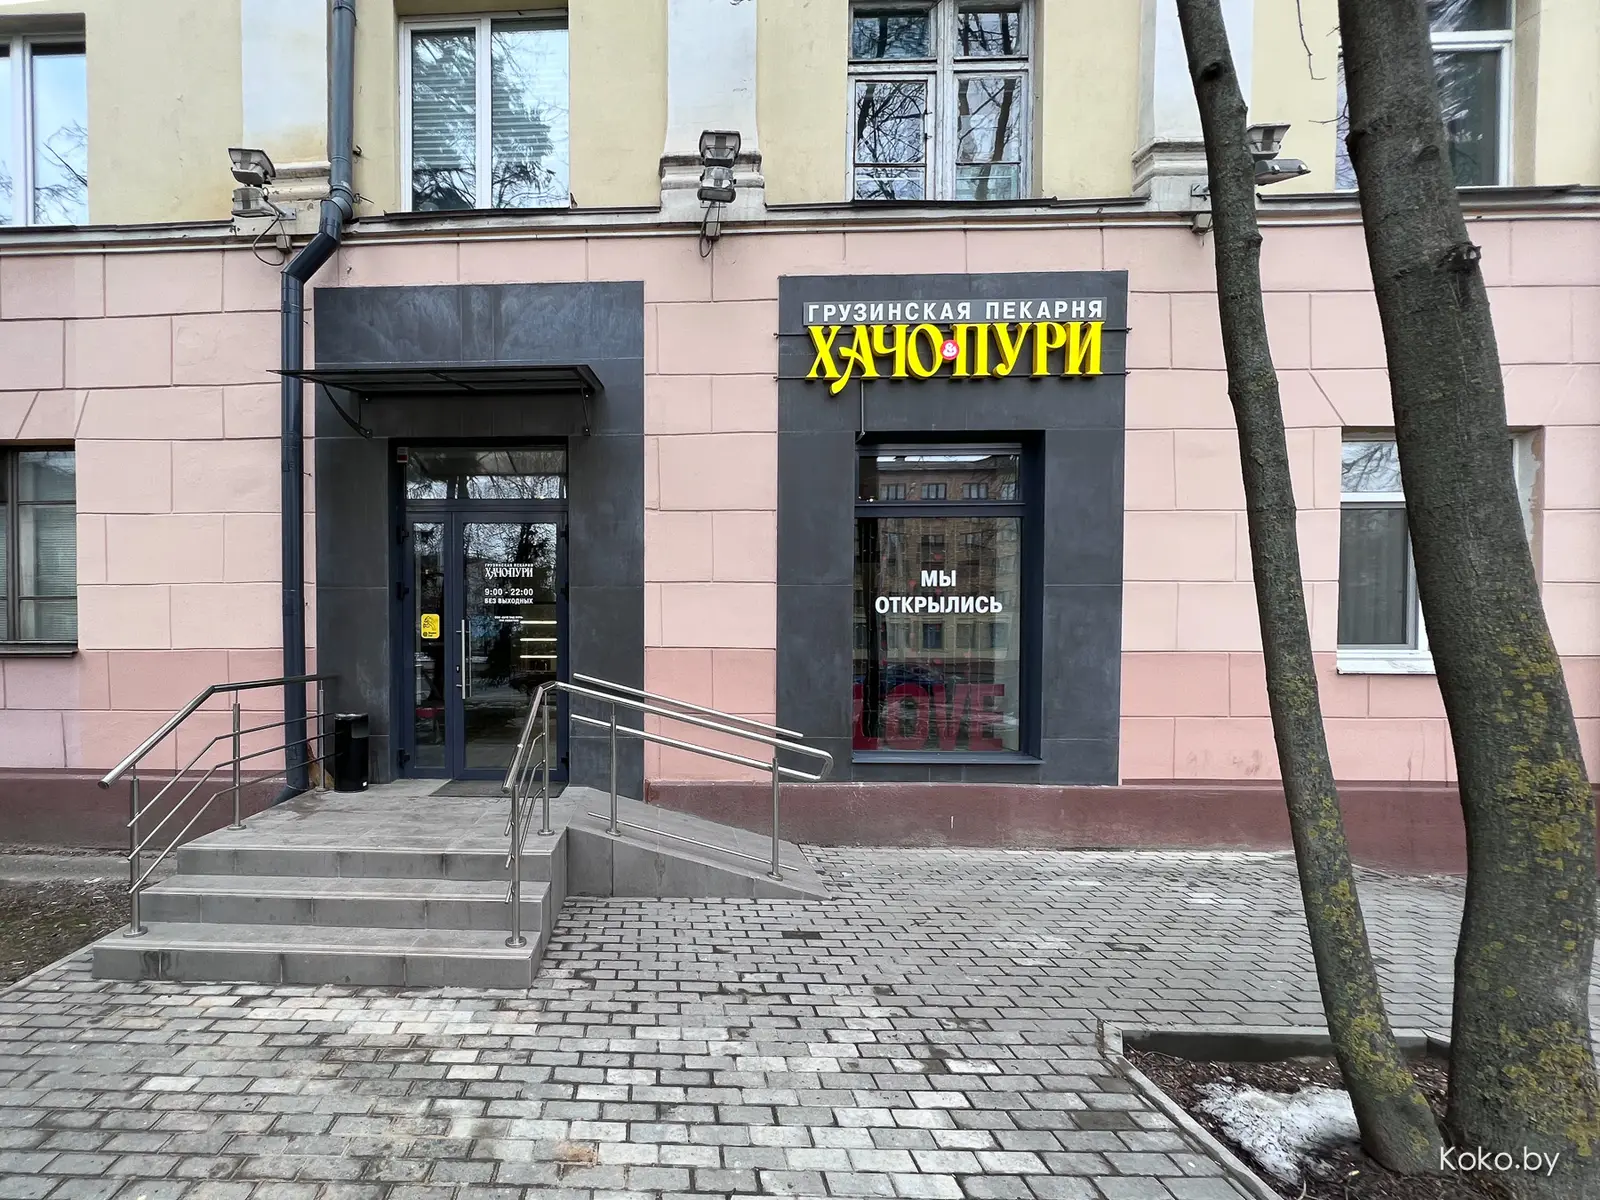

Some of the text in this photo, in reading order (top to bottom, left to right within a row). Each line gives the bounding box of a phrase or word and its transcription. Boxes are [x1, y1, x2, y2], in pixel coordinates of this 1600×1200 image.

[808, 300, 1103, 322] ГРУЗИНСКАЯ ПЕКАРНЯ
[921, 570, 957, 587] МЫ
[484, 588, 503, 596] 9:00
[510, 588, 534, 596] 22:00
[875, 596, 1003, 614] ОТКРЫЛИСЬ
[853, 683, 1005, 751] LOVE
